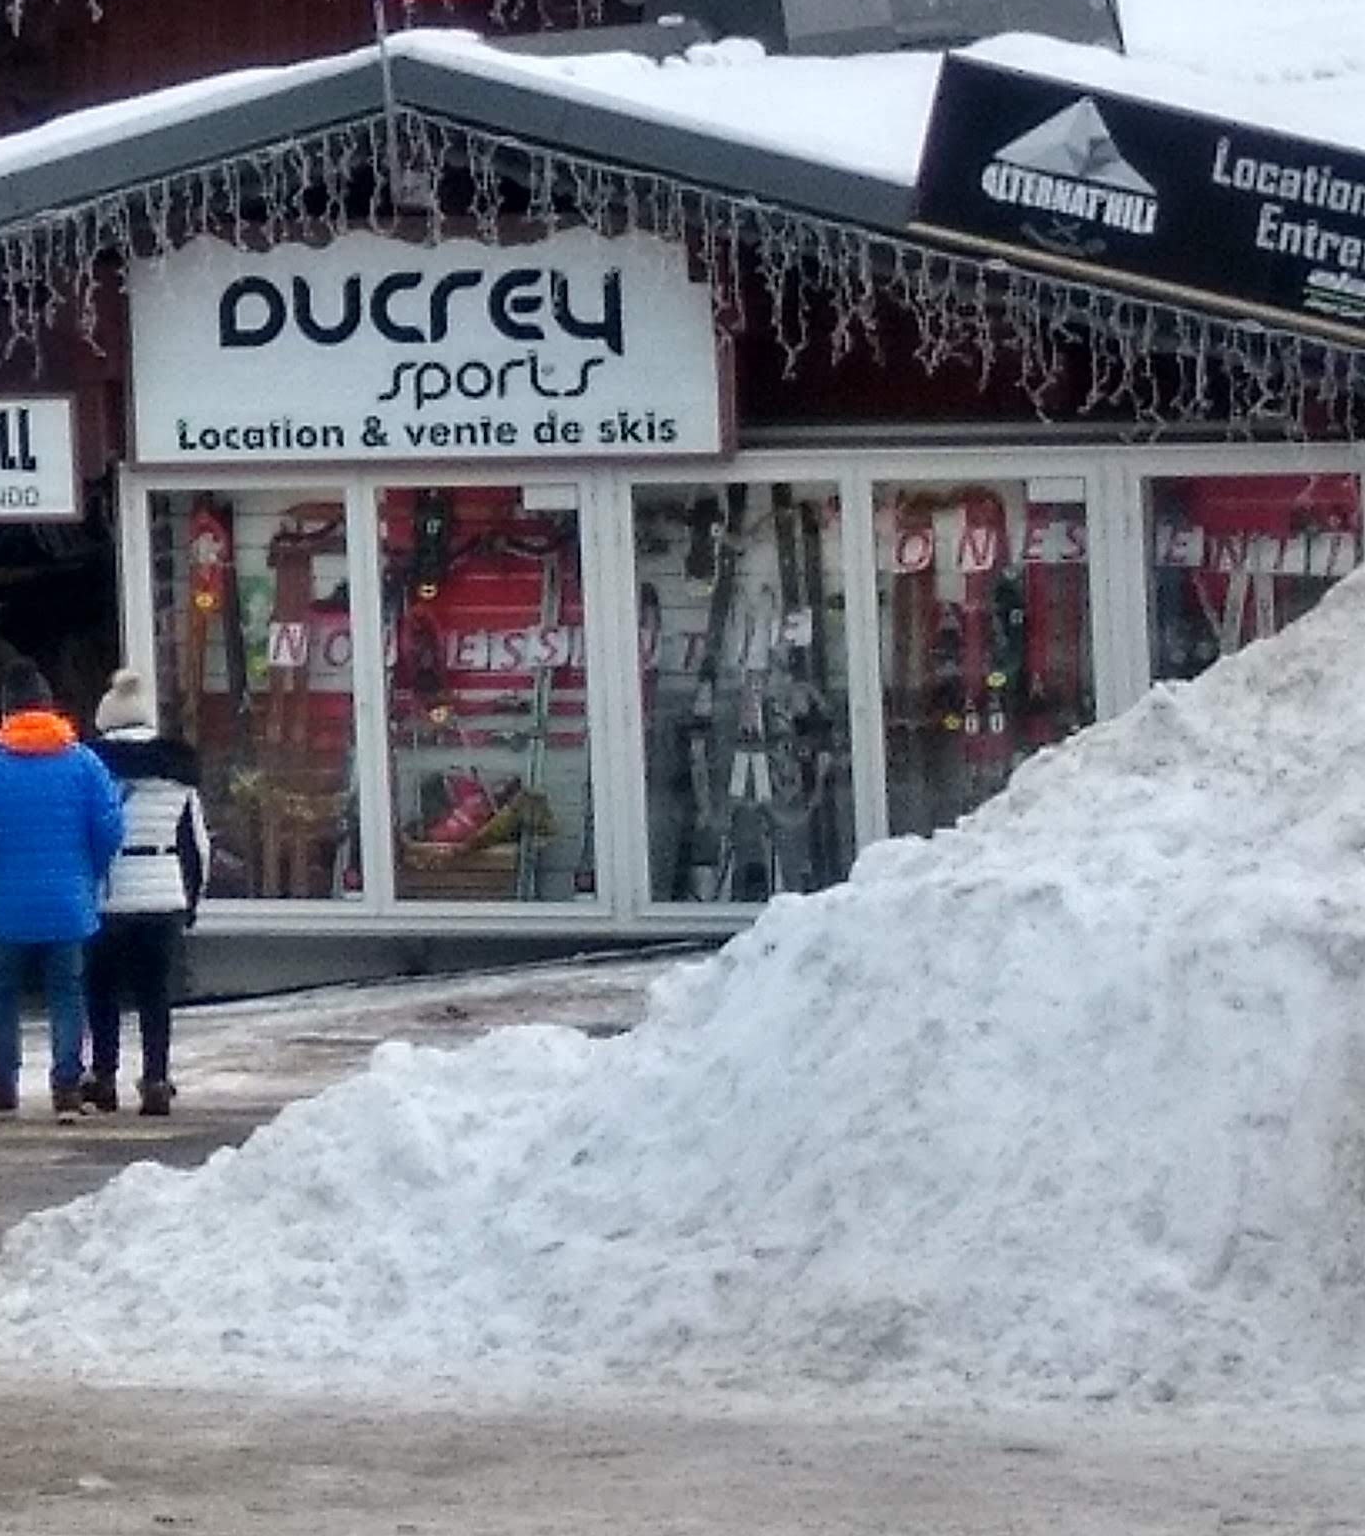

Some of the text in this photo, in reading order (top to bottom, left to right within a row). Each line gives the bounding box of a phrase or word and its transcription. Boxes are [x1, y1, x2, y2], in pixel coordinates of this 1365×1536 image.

[1255, 201, 1365, 270] Entre
[377, 349, 605, 410] sports
[176, 410, 679, 452] Location & vente de skis
